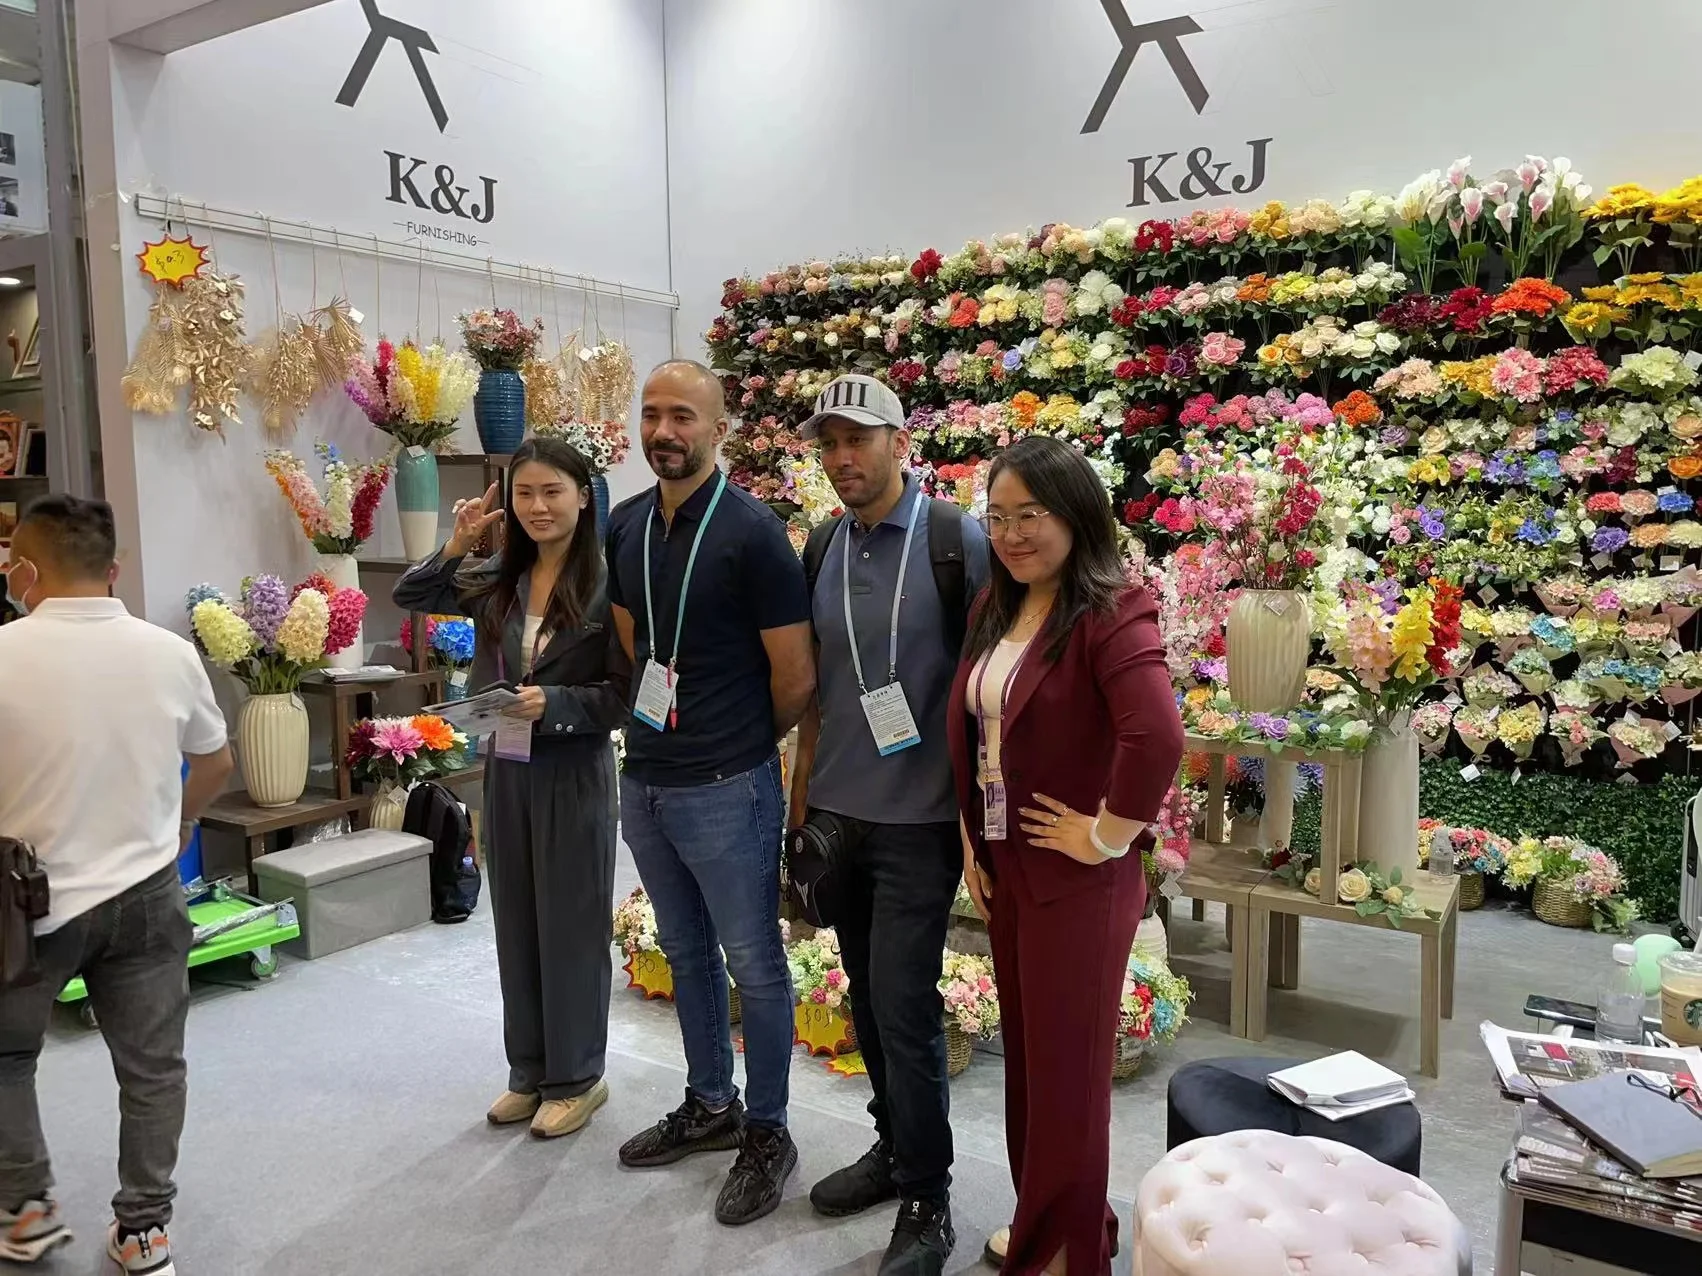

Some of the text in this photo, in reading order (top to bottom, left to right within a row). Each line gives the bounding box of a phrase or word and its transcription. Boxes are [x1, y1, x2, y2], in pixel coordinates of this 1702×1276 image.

[383, 150, 498, 224] K&J
[1126, 137, 1273, 208] K&J
[407, 221, 477, 247] FURNISHING
[820, 381, 869, 412] VIII
